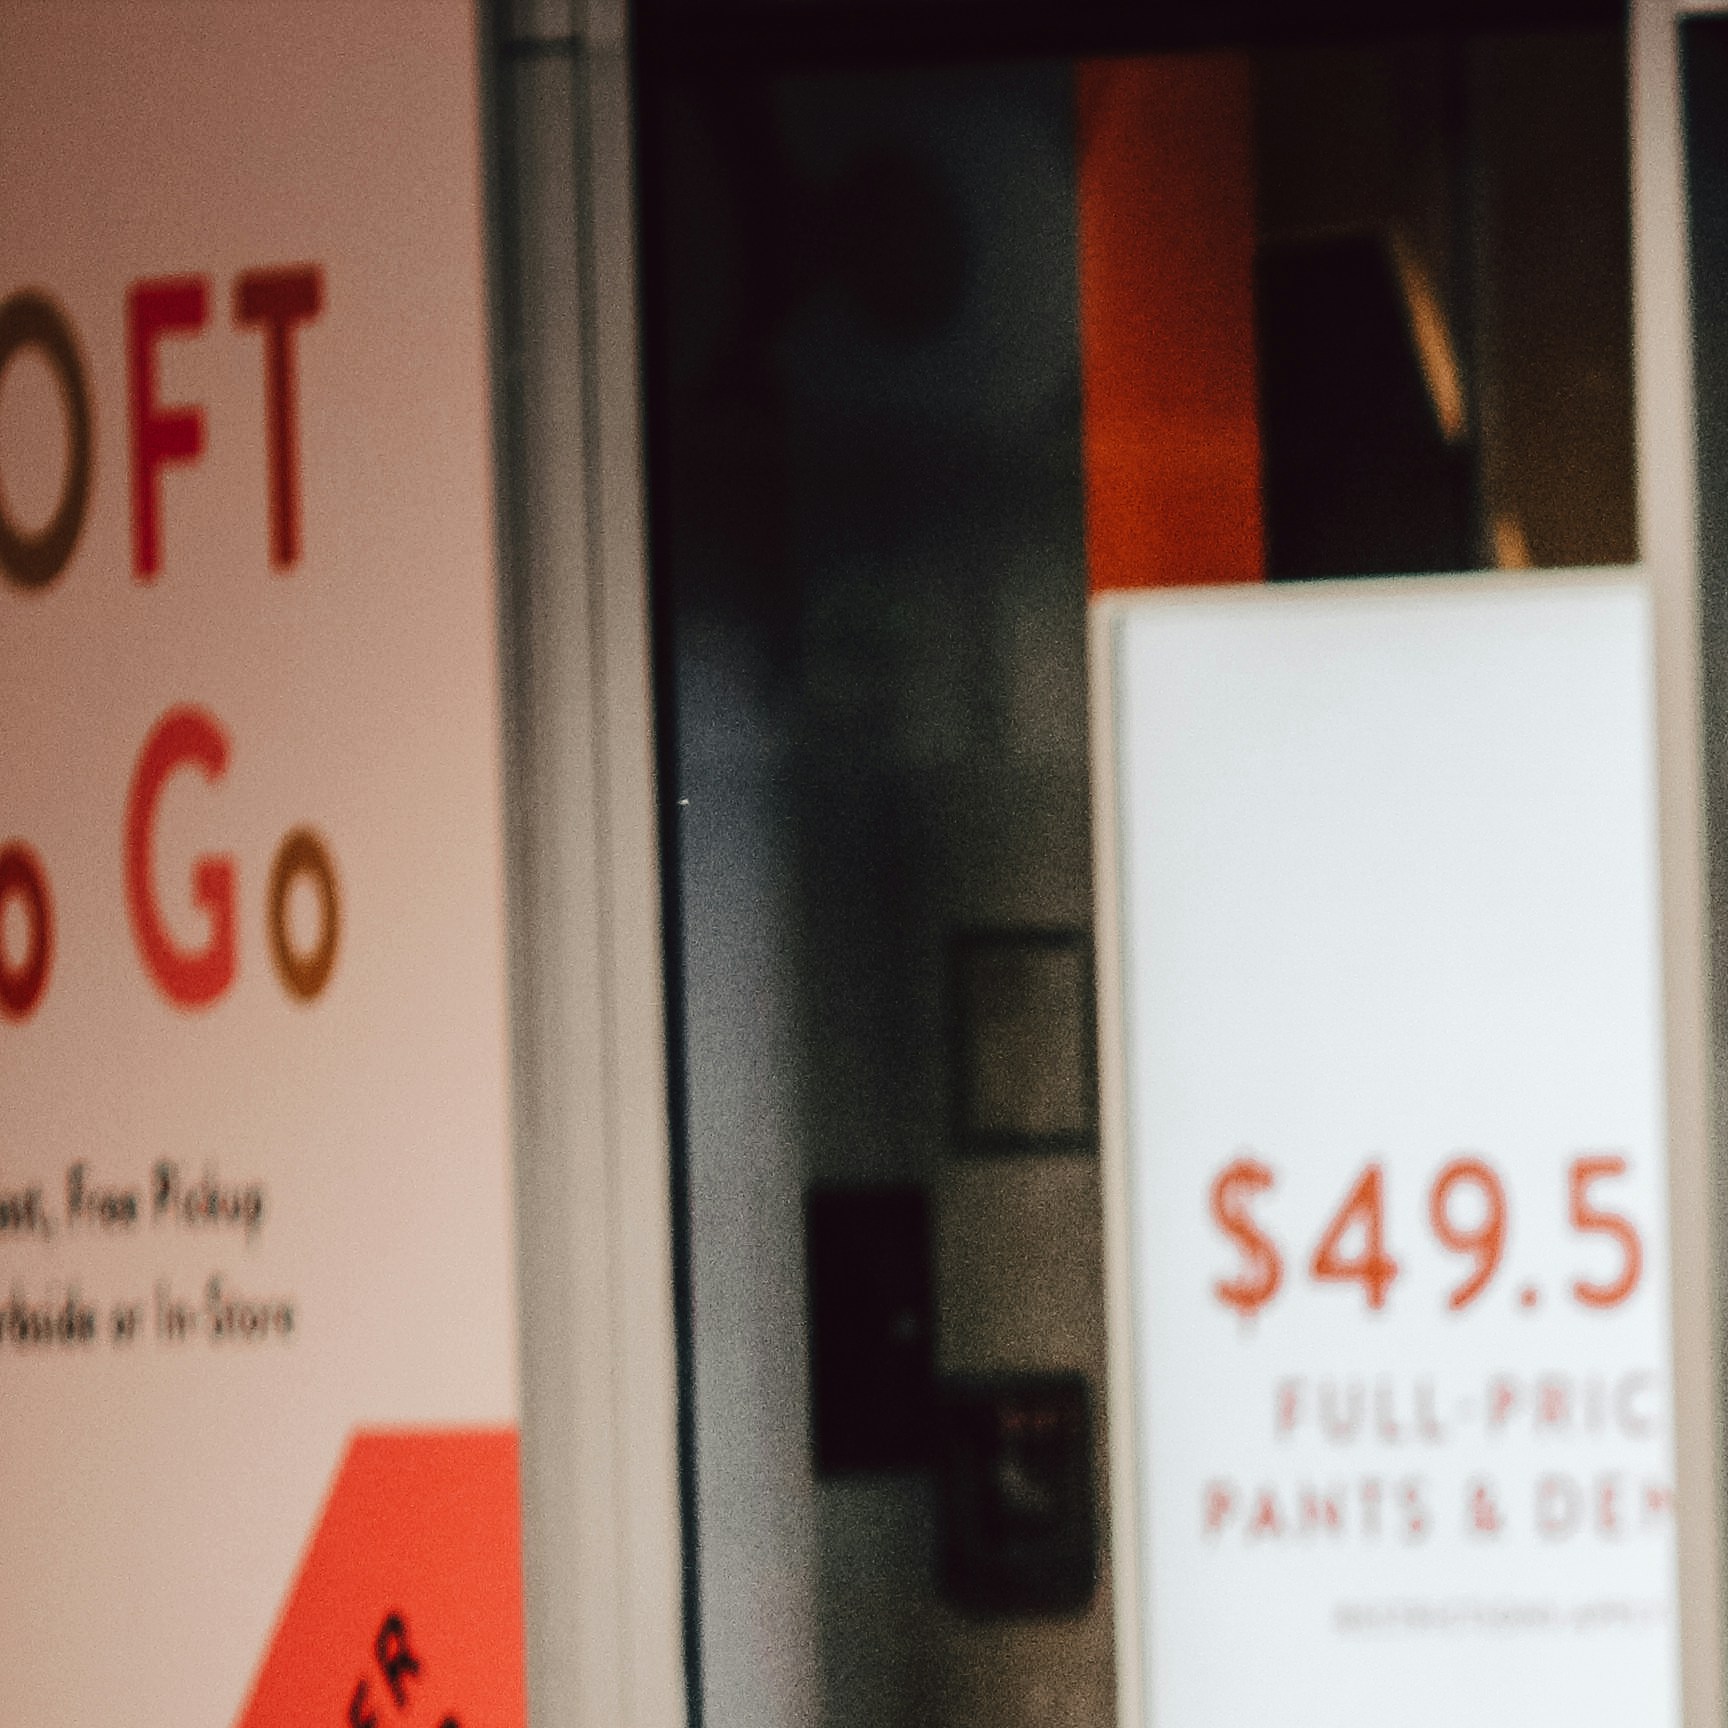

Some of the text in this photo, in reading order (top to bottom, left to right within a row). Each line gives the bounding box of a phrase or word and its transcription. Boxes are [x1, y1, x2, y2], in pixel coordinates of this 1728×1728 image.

[123, 704, 341, 1010] Go
[150, 1158, 267, 1247] Pickup
[1207, 1152, 1645, 1328] $49.5
[1202, 1475, 1431, 1546] PANTS
[1465, 1471, 1504, 1541] &
